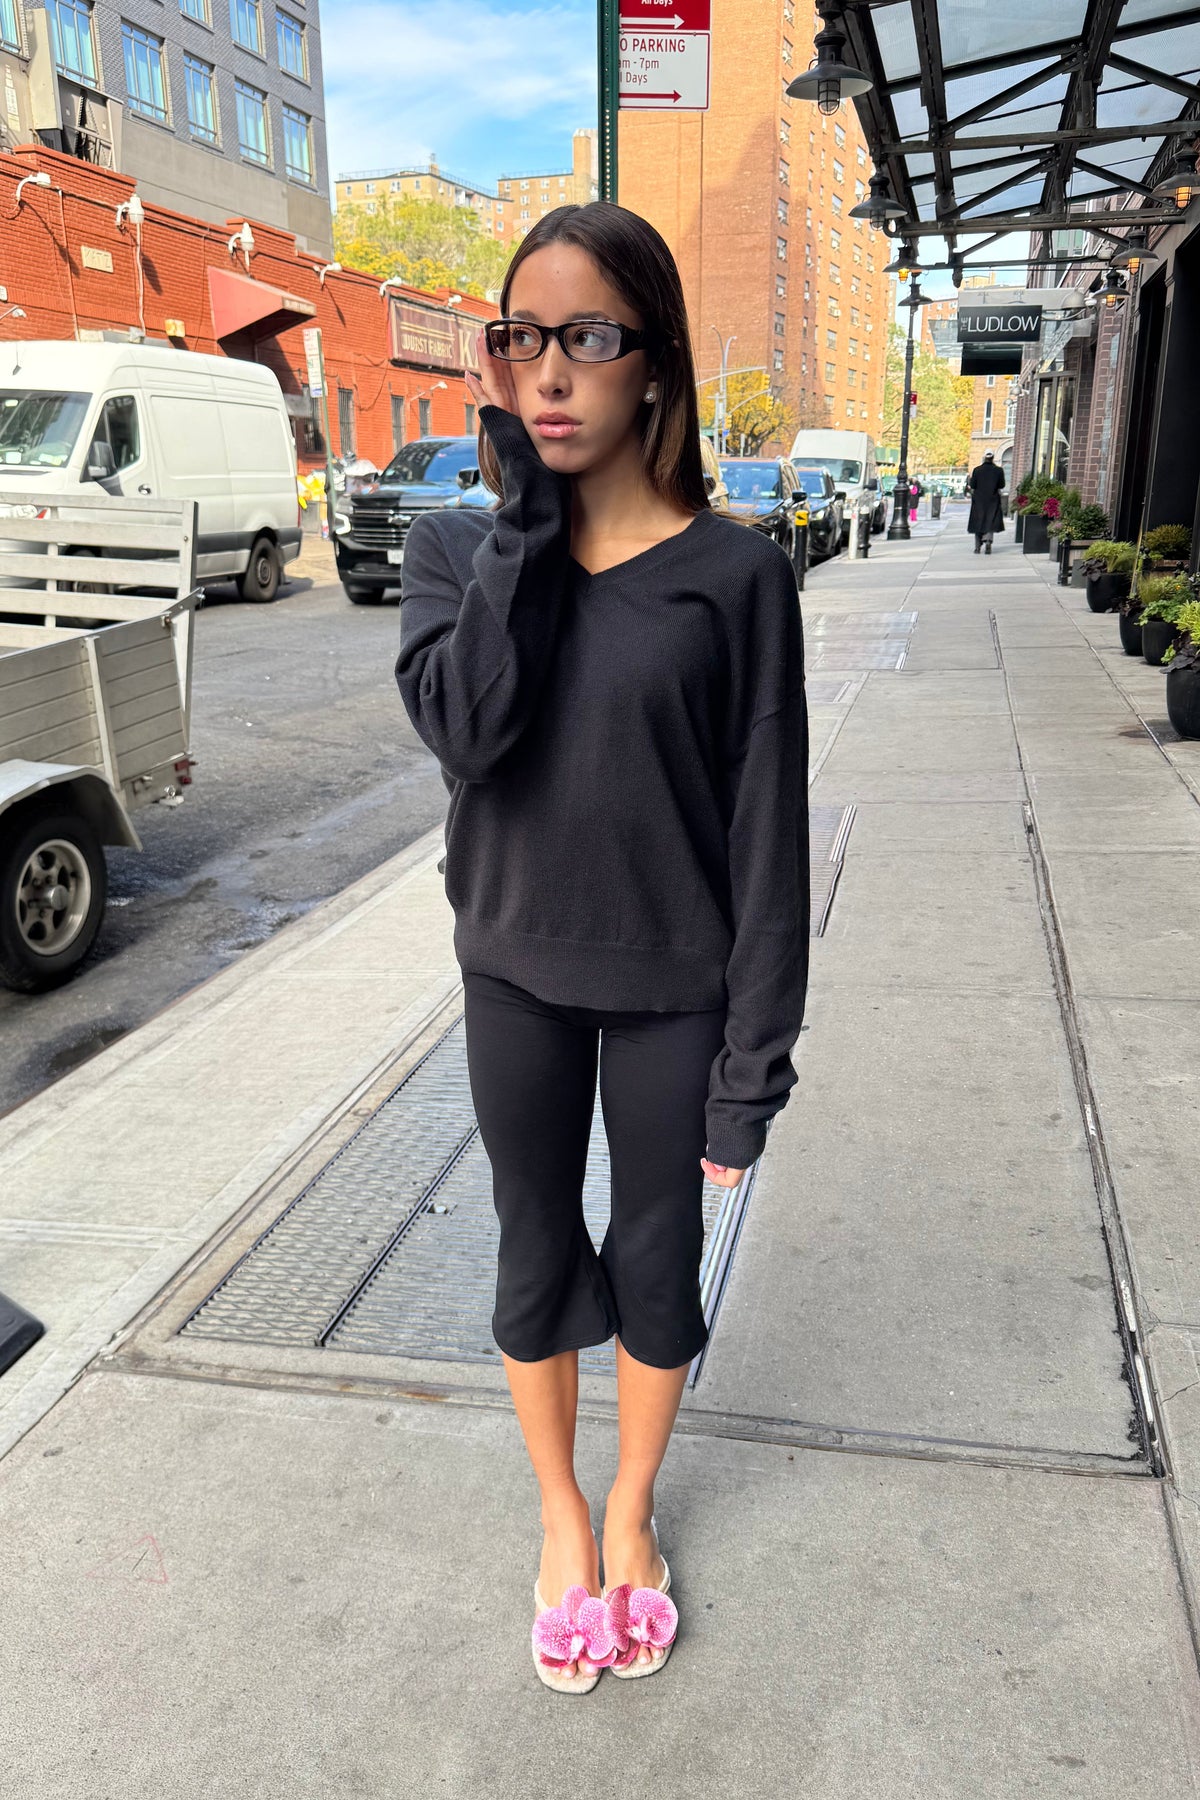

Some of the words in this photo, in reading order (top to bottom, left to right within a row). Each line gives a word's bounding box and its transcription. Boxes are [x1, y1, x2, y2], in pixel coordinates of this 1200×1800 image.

[619, 38, 628, 51] O
[632, 38, 686, 52] PARKING
[618, 59, 631, 68] am
[640, 57, 659, 71] 7pm
[626, 72, 648, 86] Days
[967, 315, 1039, 332] LUDLOW
[458, 329, 479, 369] K
